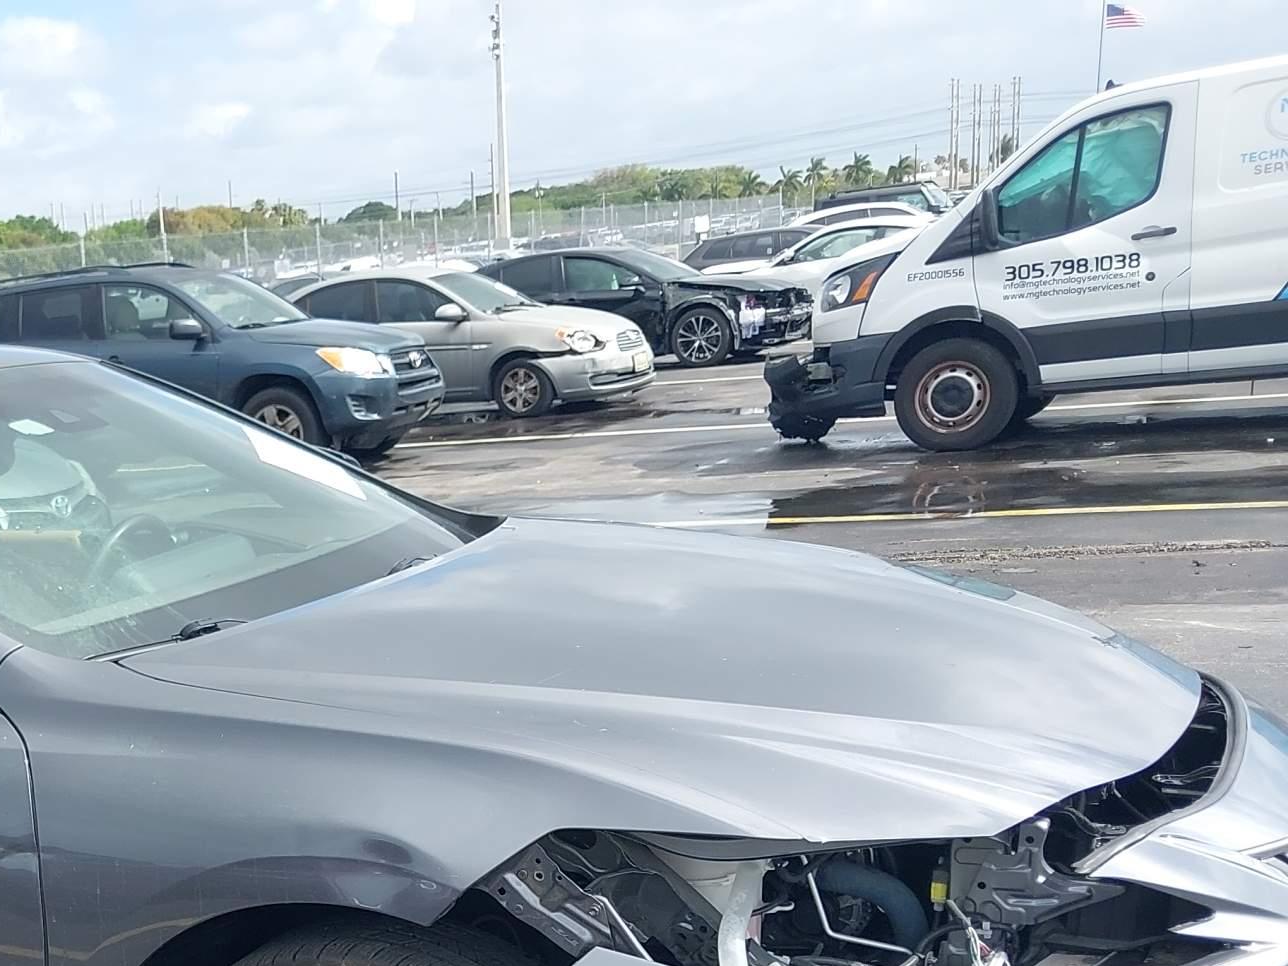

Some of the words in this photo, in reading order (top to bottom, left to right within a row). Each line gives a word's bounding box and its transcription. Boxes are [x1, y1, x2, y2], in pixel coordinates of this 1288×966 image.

[907, 267, 965, 282] EF20001556
[1005, 252, 1141, 281] 305.798.1038
[1003, 270, 1140, 290] info@mgtechnologyservices.net
[1002, 281, 1140, 300] www.mgtechnologyservices.net
